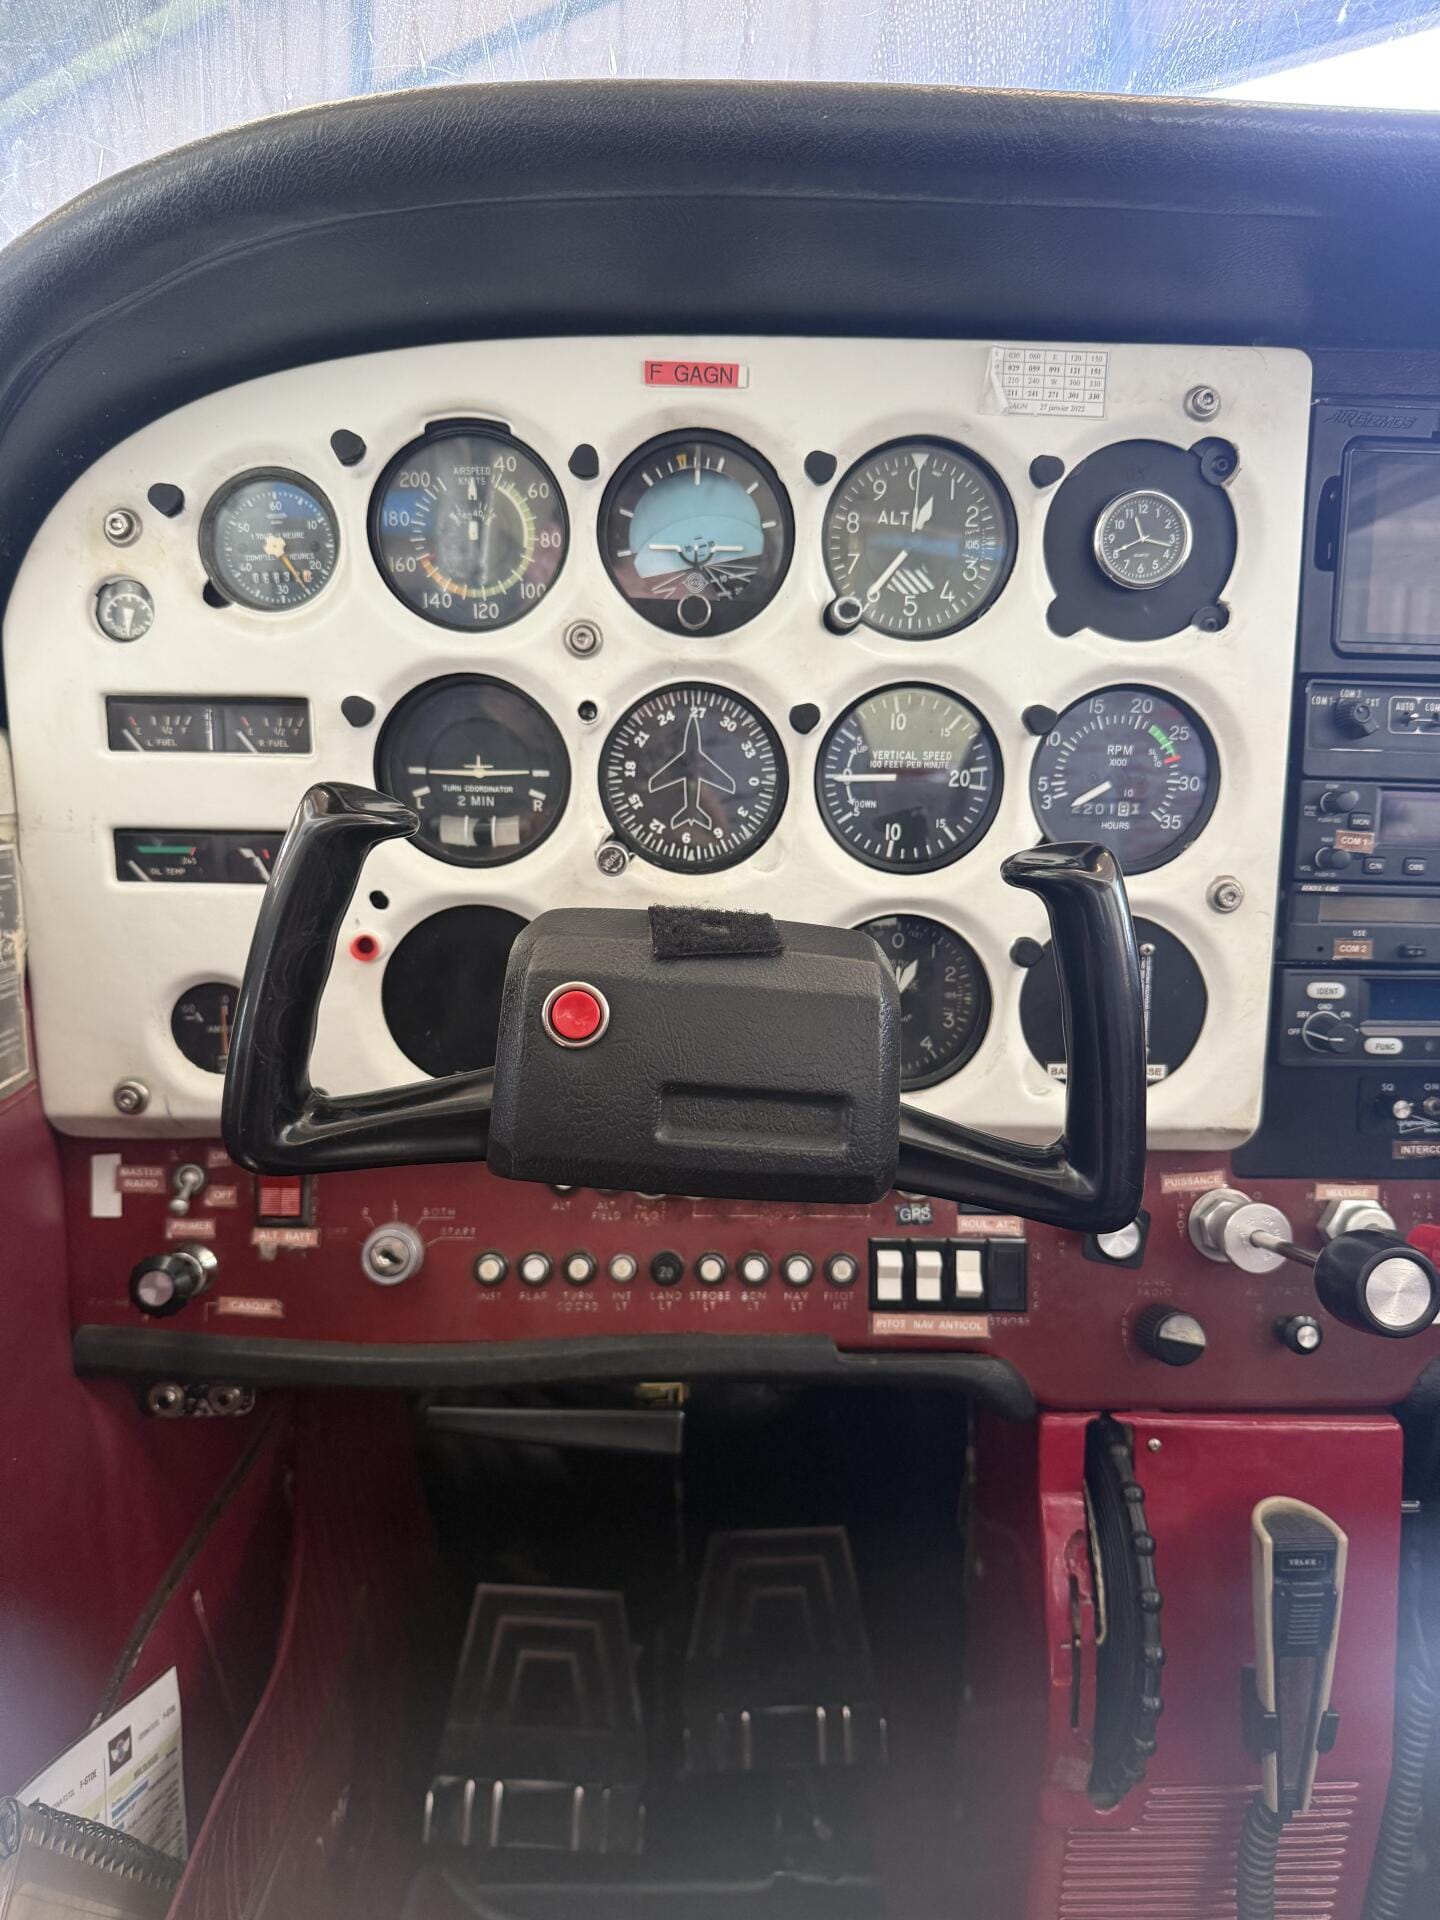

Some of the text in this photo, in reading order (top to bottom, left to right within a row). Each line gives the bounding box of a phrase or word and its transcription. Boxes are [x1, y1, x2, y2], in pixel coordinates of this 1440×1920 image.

[650, 363, 733, 385] F GAGN
[494, 456, 517, 472] 40
[453, 466, 491, 476] AIRSPEED
[400, 471, 431, 488] 200
[528, 483, 549, 498] 60
[873, 479, 887, 501] 9
[950, 478, 956, 501] 1
[270, 501, 282, 511] 60
[1138, 504, 1149, 514] 12
[383, 511, 410, 527] 180
[877, 511, 910, 526] ALT
[965, 506, 978, 528] 2
[1125, 509, 1134, 519] 11
[1156, 508, 1160, 519] 1
[237, 523, 250, 533] 50
[307, 520, 318, 530] 10
[846, 512, 859, 534] 8
[1114, 519, 1125, 530] 10
[1165, 519, 1172, 529] 2
[540, 533, 562, 548] 80
[1108, 534, 1115, 544] 9
[1169, 534, 1175, 544] 3
[1163, 549, 1169, 559] 4
[240, 563, 252, 572] 40
[310, 560, 322, 570] 20
[389, 557, 417, 572] 160
[847, 553, 860, 575] 7
[1123, 559, 1130, 570] 7
[1137, 563, 1144, 573] 6
[1152, 560, 1159, 570] 5
[963, 559, 978, 582] 3
[277, 585, 289, 595] 30
[520, 583, 547, 600] 100
[939, 580, 955, 602] 4
[423, 593, 452, 608] 140
[903, 595, 917, 617] 5
[473, 603, 499, 619] 120
[1340, 688, 1356, 699] COM
[1088, 698, 1105, 714] 15
[1130, 698, 1153, 714] 20
[1311, 695, 1327, 706] COM
[1395, 702, 1415, 712] AUTO
[657, 710, 676, 727] 24
[689, 707, 707, 719] 27
[719, 716, 737, 732] 30
[890, 713, 907, 731] 10
[940, 727, 951, 737] 15
[1168, 725, 1189, 740] 25
[156, 738, 178, 748] FUEL
[268, 739, 290, 748] FUEL
[634, 730, 650, 748] 21
[856, 737, 863, 746] 5
[741, 740, 756, 759] 33
[1106, 744, 1134, 755] RPM
[872, 750, 952, 761] VERTICAL SPEED
[624, 761, 637, 778] 18
[885, 760, 903, 769] FEET
[906, 761, 922, 769] PER
[924, 761, 950, 769] MINUTE
[748, 777, 760, 786] 0
[949, 769, 971, 787] 20
[1037, 776, 1048, 791] 5
[1178, 776, 1200, 791] 30
[442, 783, 514, 794] TURN COORDINATOR
[416, 797, 425, 810] L
[457, 795, 496, 808] 2 MIN
[533, 799, 543, 812] R
[628, 793, 644, 810] 15
[854, 800, 877, 809] DOWN
[1041, 794, 1051, 810] 3
[737, 806, 749, 817] 3
[853, 807, 860, 817] 5
[649, 818, 666, 834] 12
[935, 818, 946, 828] 15
[1101, 821, 1130, 830] HOURS
[1160, 815, 1182, 830] 35
[885, 823, 901, 841] 10
[1340, 836, 1361, 846] COM
[165, 867, 187, 877] TEMP
[891, 932, 905, 949] 0
[1339, 944, 1368, 953] COM 2
[944, 966, 956, 982] 2
[1316, 987, 1339, 996] IDENT
[942, 1012, 955, 1028] 3
[1287, 1028, 1300, 1036] OFF
[920, 1035, 933, 1051] 4
[1374, 1042, 1396, 1051] FUNC
[119, 1168, 163, 1177] MASTER
[123, 1179, 159, 1188] RADIO
[1163, 1175, 1222, 1188] PUISSANCE
[213, 1190, 234, 1199] OFF
[1325, 1188, 1369, 1198] MIXTURE
[552, 1200, 571, 1211] ALT
[422, 1207, 457, 1217] BOTH
[591, 1210, 622, 1221] FIELD
[899, 1206, 932, 1222] GPS
[171, 1221, 213, 1231] PRIMER
[650, 1291, 683, 1301] LAND
[689, 1291, 731, 1301] STROBE
[783, 1291, 810, 1301] NAV
[658, 1301, 673, 1312] LT
[875, 1318, 984, 1331] PITOT NAV ANTICOL
